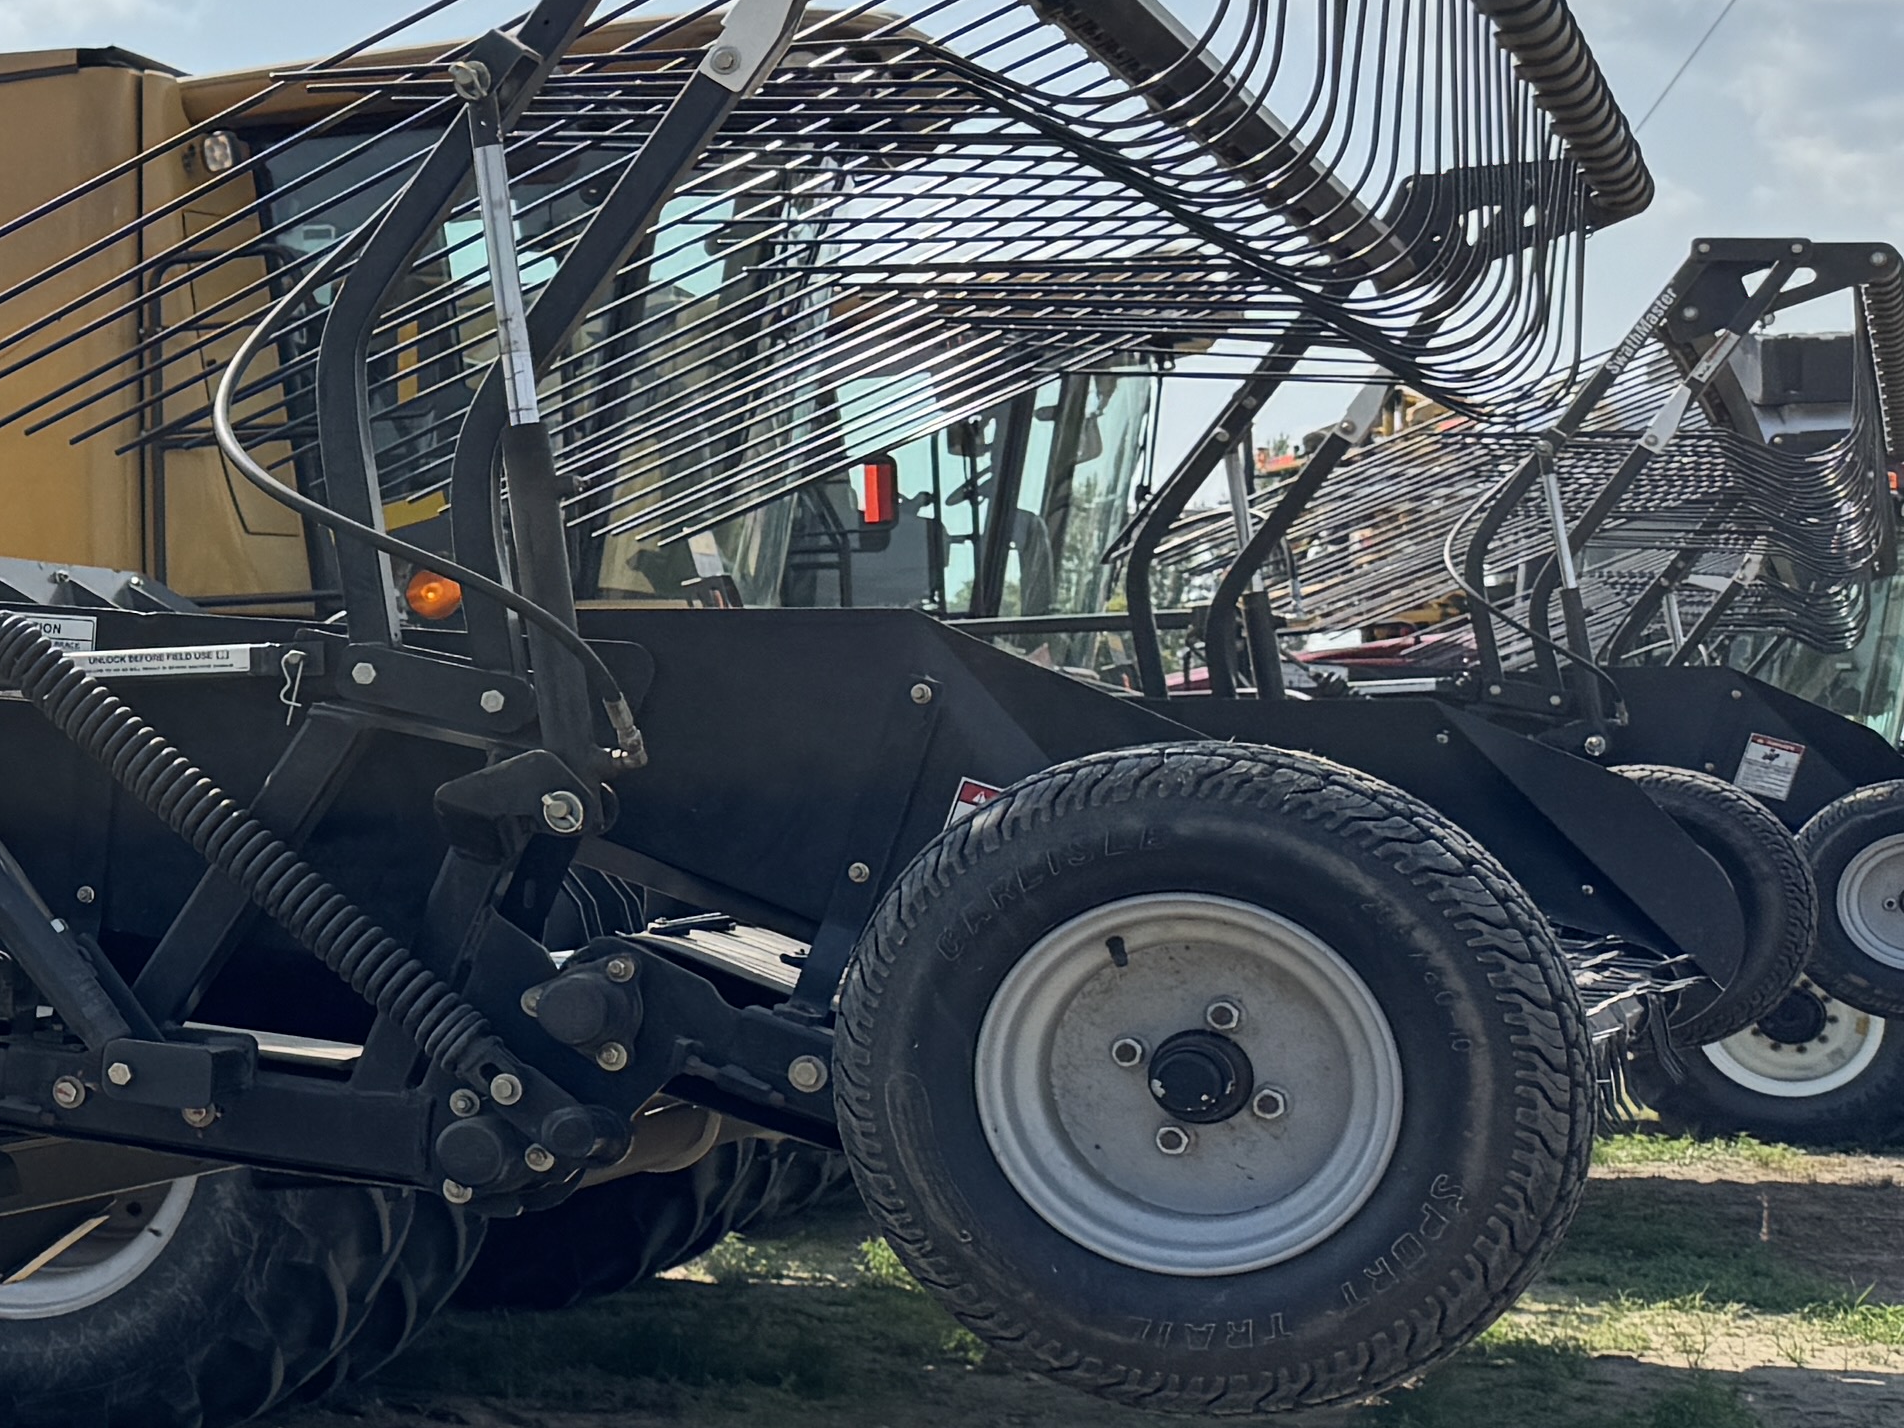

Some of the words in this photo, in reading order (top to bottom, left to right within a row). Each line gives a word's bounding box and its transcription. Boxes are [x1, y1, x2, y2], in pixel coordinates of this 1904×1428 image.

[1605, 287, 1677, 374] SwathMaster
[88, 655, 126, 665] UNLOCK
[128, 653, 165, 663] BEFORE
[166, 651, 192, 661] FIELD
[194, 650, 212, 660] USE
[936, 825, 1167, 961] CARLISLE
[1342, 1174, 1467, 1309] SPORT
[1128, 1312, 1292, 1351] TRAIL
